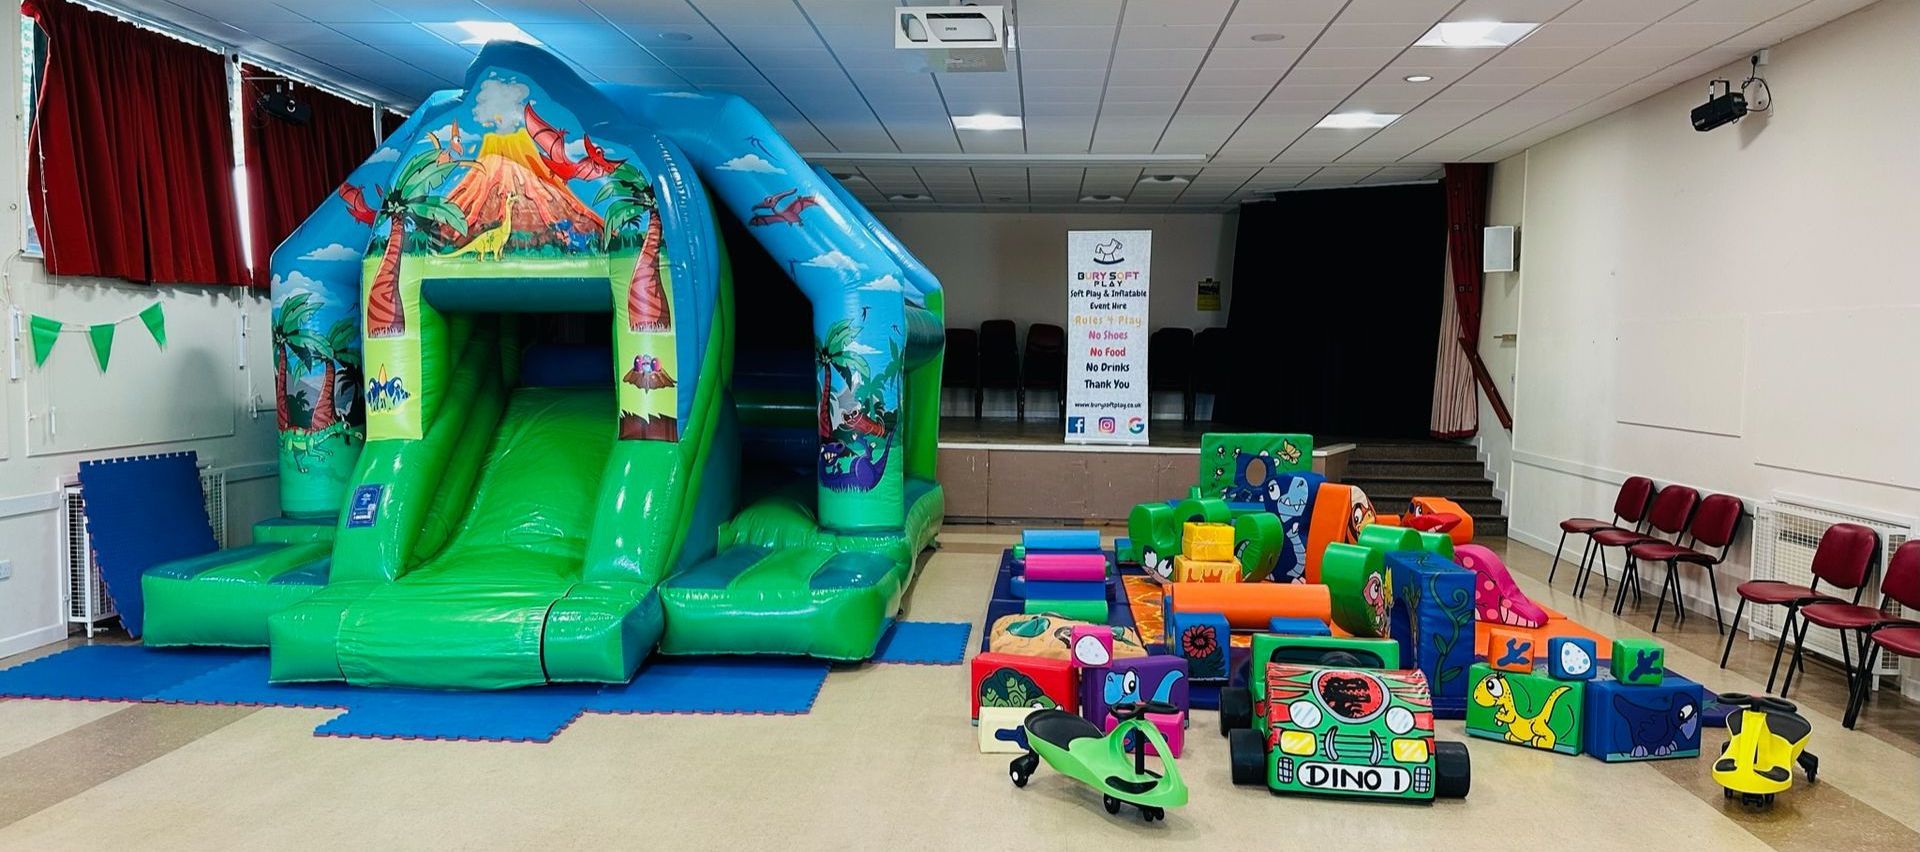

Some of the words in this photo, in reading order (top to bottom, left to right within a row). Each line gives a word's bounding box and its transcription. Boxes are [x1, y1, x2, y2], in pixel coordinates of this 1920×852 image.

[1077, 272, 1107, 280] BURY
[1109, 272, 1140, 280] SOFT
[1070, 289, 1084, 298] Soft
[1085, 289, 1101, 299] Play
[1111, 289, 1147, 298] Inflatable
[1090, 302, 1110, 310] Event
[1112, 302, 1127, 310] Hire
[1075, 315, 1103, 325] Rules
[1107, 316, 1113, 325] 4
[1118, 315, 1141, 328] Play
[1088, 330, 1101, 340] No
[1103, 330, 1128, 340] Shoes
[1090, 347, 1102, 356] No
[1105, 347, 1126, 357] Food
[1086, 363, 1098, 372] No
[1101, 363, 1130, 372] Drinks
[1084, 379, 1112, 389] Thank
[1113, 379, 1130, 389] You
[1305, 765, 1382, 791] DINO
